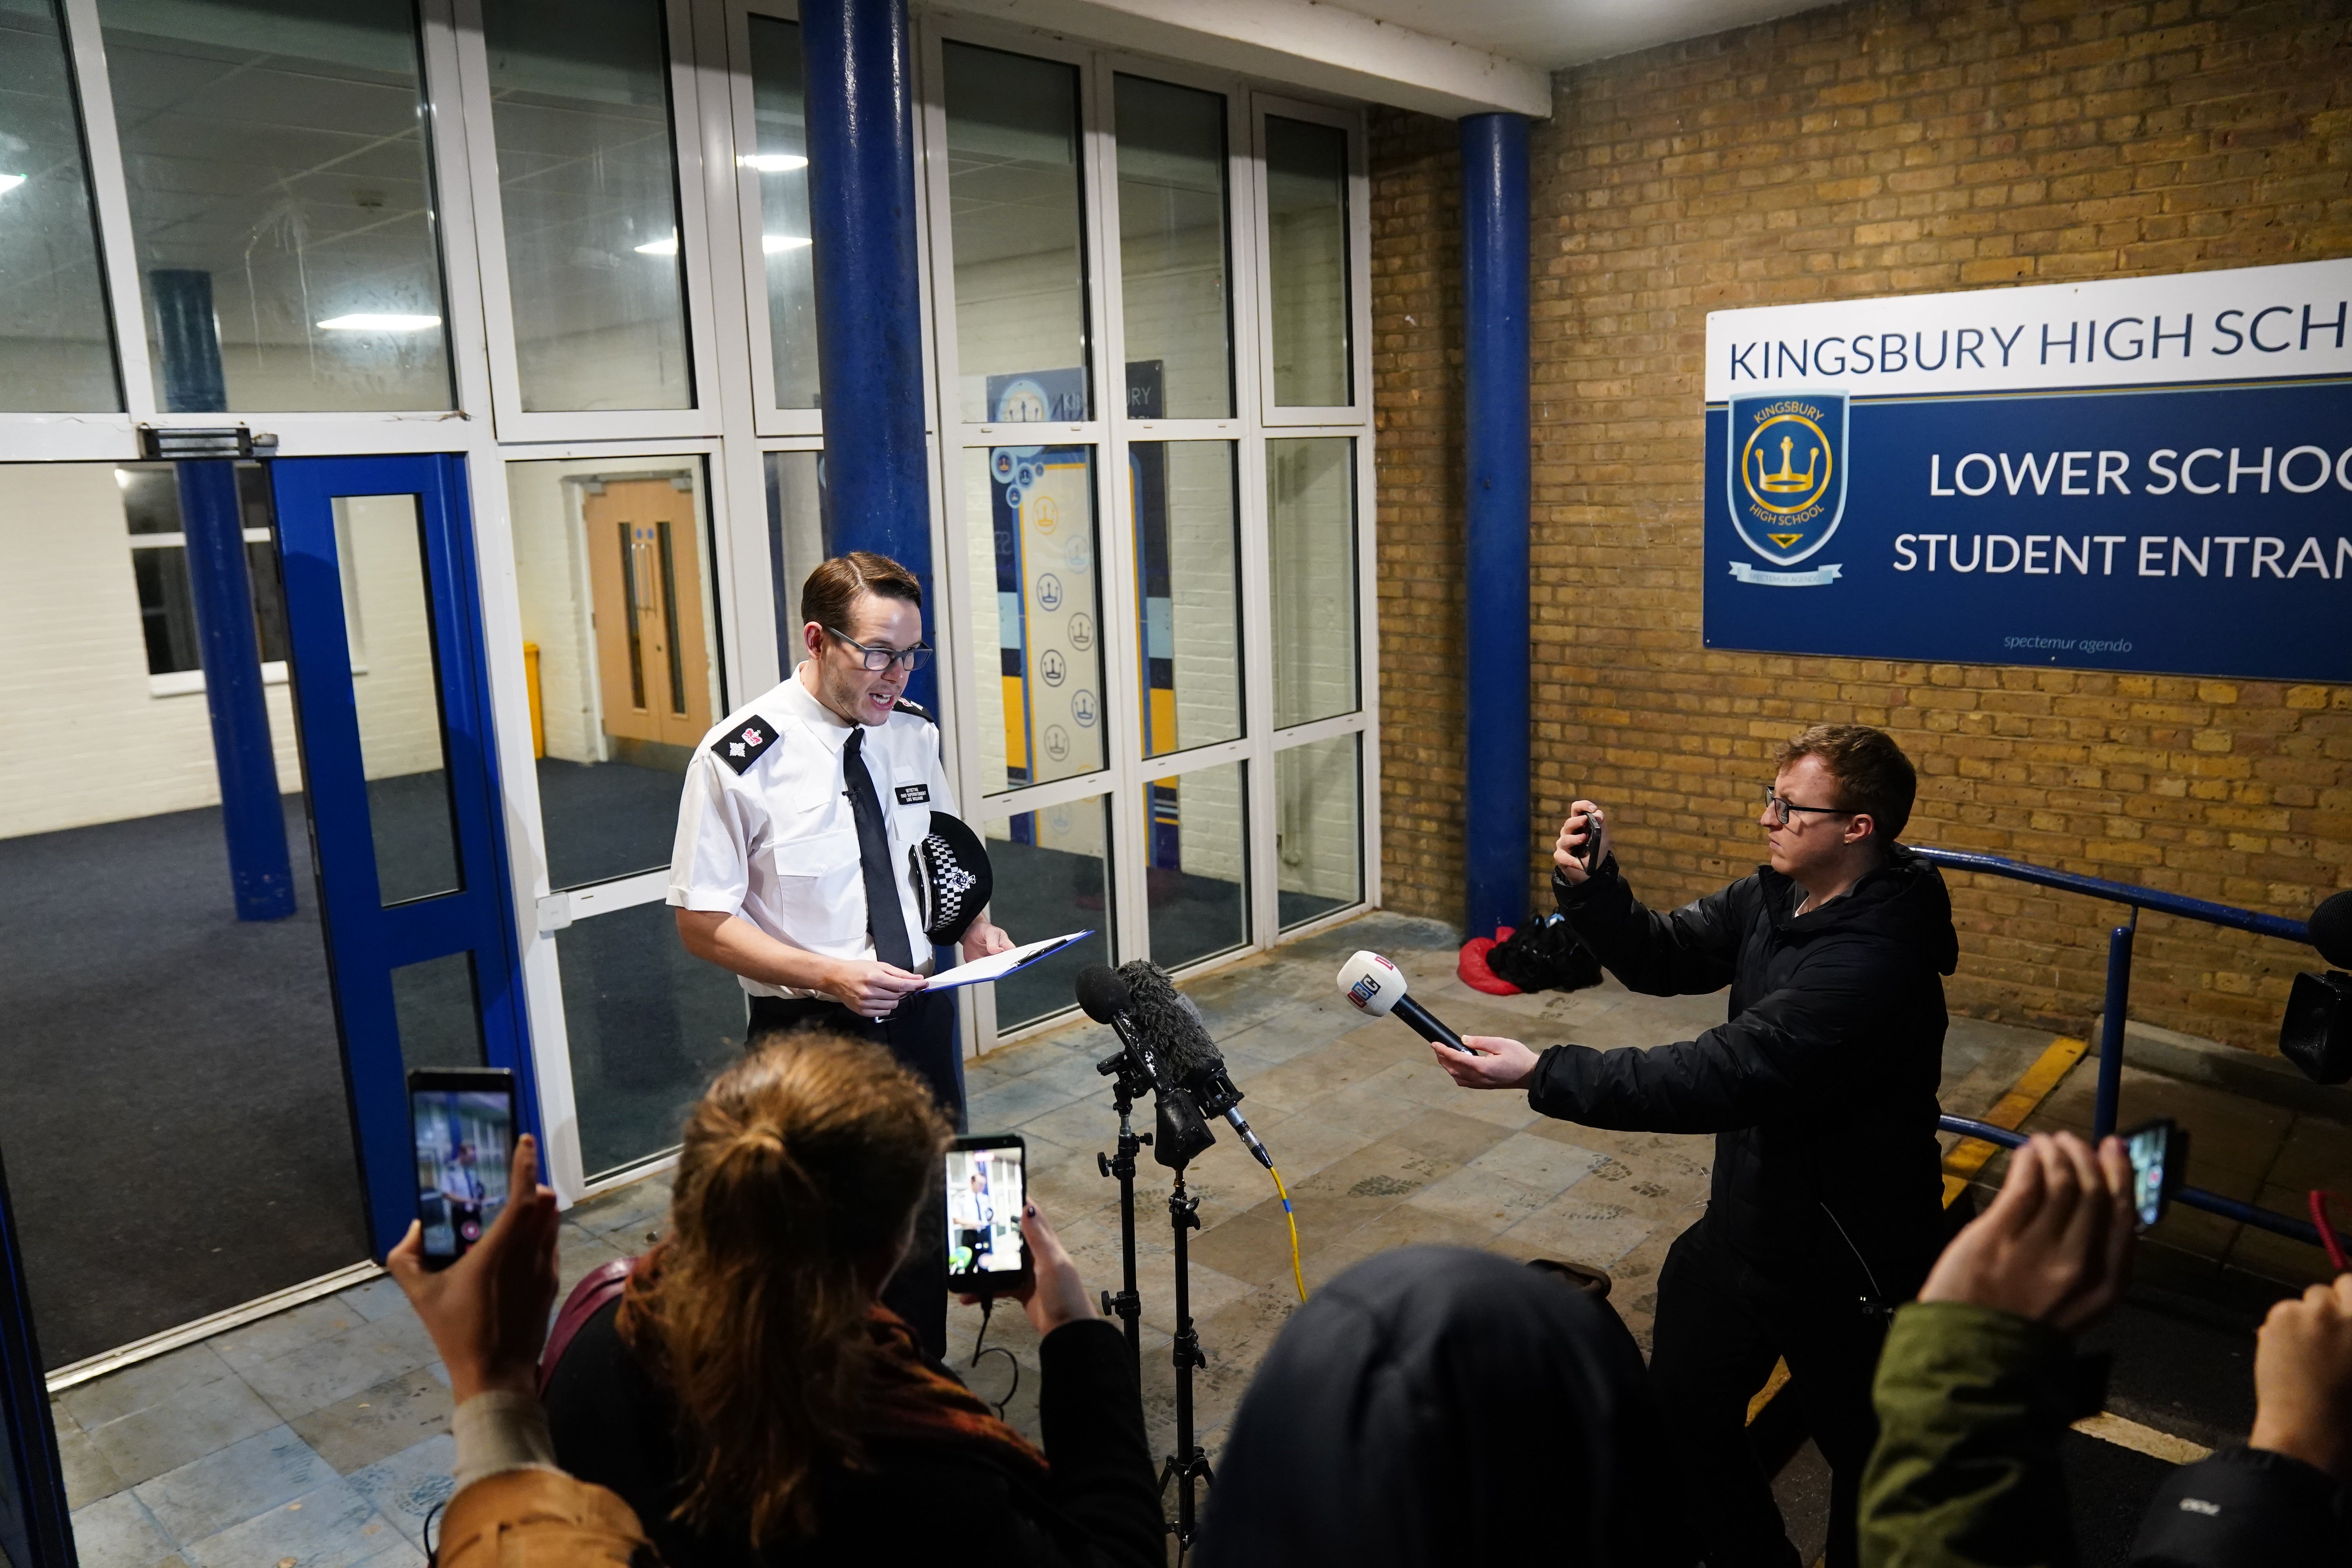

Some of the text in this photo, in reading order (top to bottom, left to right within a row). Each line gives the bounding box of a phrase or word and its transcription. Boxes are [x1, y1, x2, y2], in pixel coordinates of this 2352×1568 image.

[1731, 301, 2348, 380] KINGSBURY HIGH SCH
[1753, 401, 1824, 423] KINGSBURY
[1930, 450, 2131, 496] LOWER
[1749, 503, 1825, 526] HIGH SCHOOL
[1893, 533, 2126, 575] STUDENT
[1749, 573, 1789, 583] SPECTEMUR
[2004, 635, 2132, 654] spectemur agendo
[1348, 975, 1380, 1007] LBC
